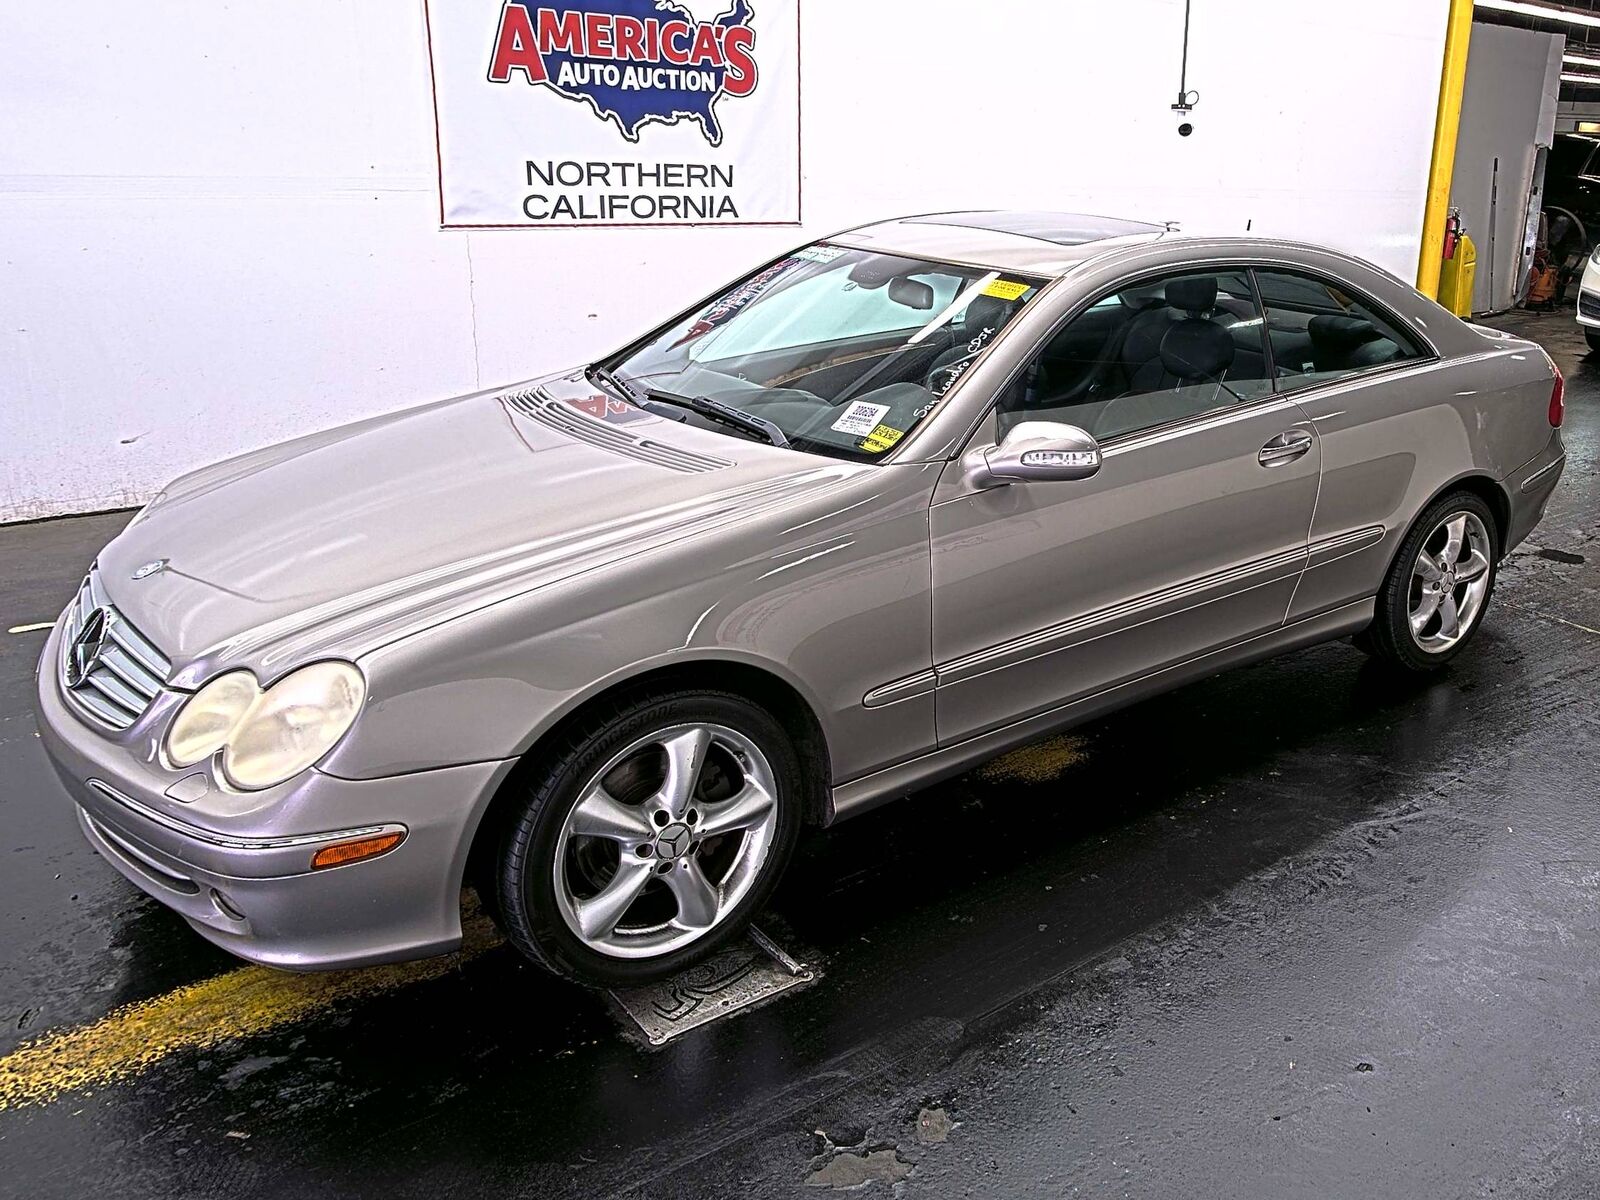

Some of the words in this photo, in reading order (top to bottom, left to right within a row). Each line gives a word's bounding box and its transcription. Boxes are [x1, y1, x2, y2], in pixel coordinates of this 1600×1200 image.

[490, 4, 757, 95] AMERICA'S
[557, 61, 620, 87] AUTO
[621, 66, 717, 92] AUCTION
[525, 160, 734, 188] NORTHERN
[522, 194, 739, 220] CALIFORNIA
[913, 397, 941, 418] San
[931, 361, 970, 397] Leandro
